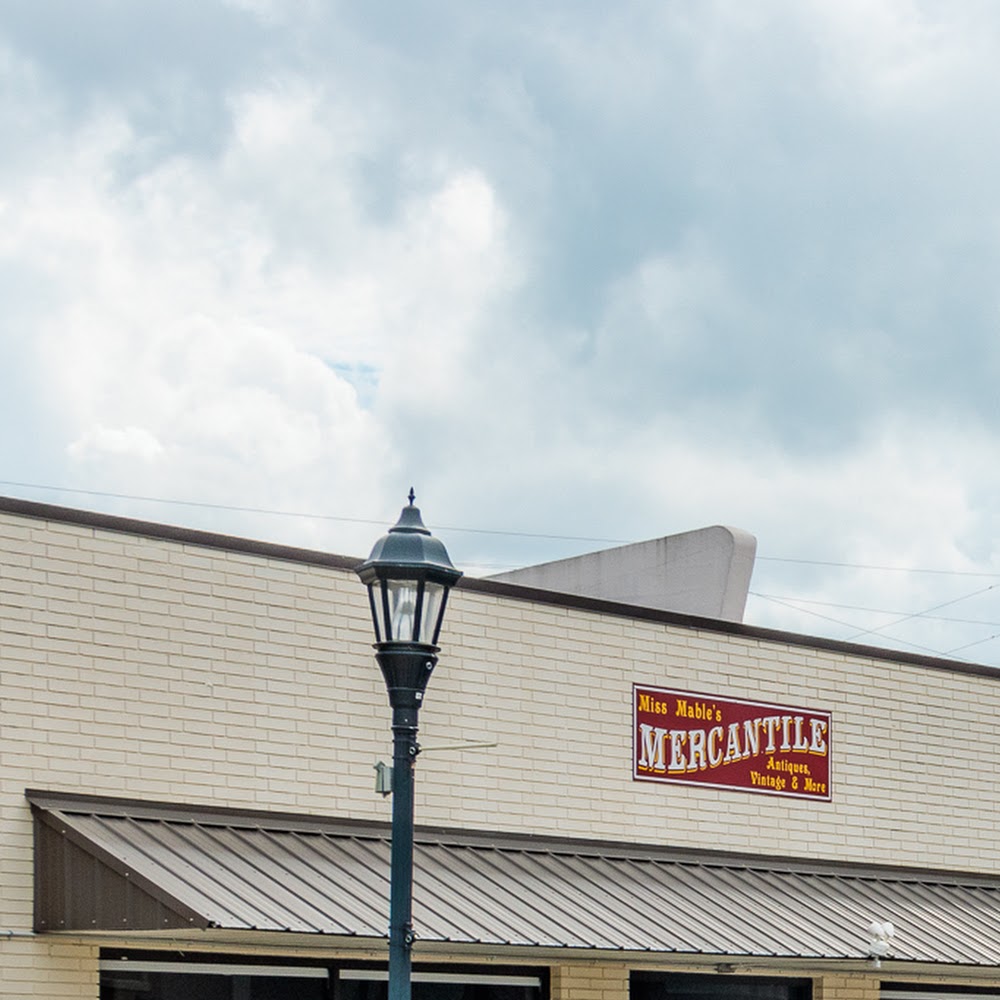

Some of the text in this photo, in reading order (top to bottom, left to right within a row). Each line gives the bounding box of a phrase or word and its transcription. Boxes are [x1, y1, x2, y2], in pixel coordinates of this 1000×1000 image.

[638, 694, 722, 722] Miss Mable's
[638, 715, 828, 774] MERCANTILE
[766, 756, 811, 776] Antiques,
[750, 771, 826, 794] Vintage & More
